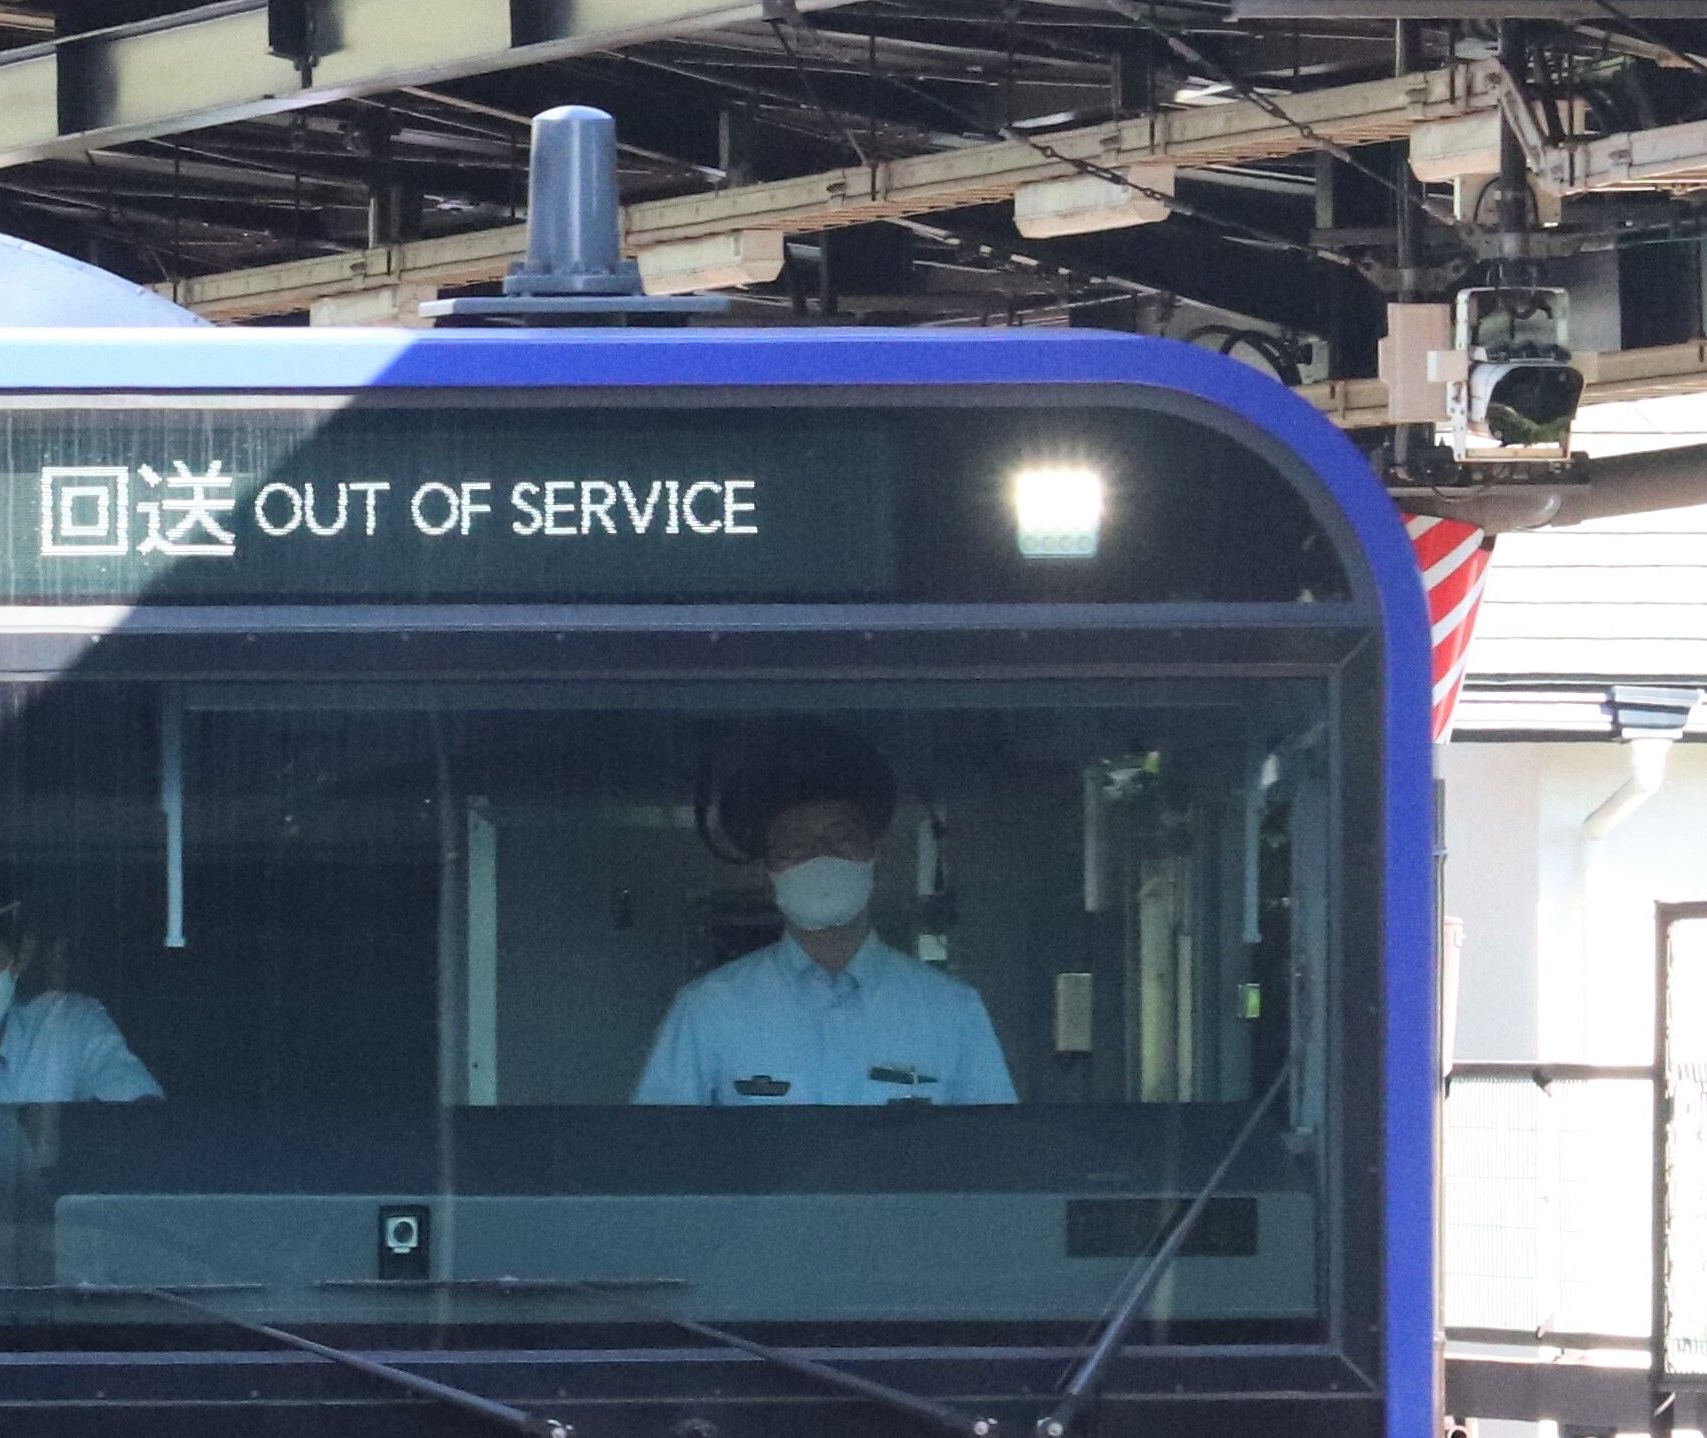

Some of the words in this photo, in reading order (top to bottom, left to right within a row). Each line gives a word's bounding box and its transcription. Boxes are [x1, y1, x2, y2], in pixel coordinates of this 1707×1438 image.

[39, 460, 236, 556] 回送
[254, 481, 391, 536] OUT
[410, 481, 491, 536] OF
[510, 479, 759, 535] SERVICE
